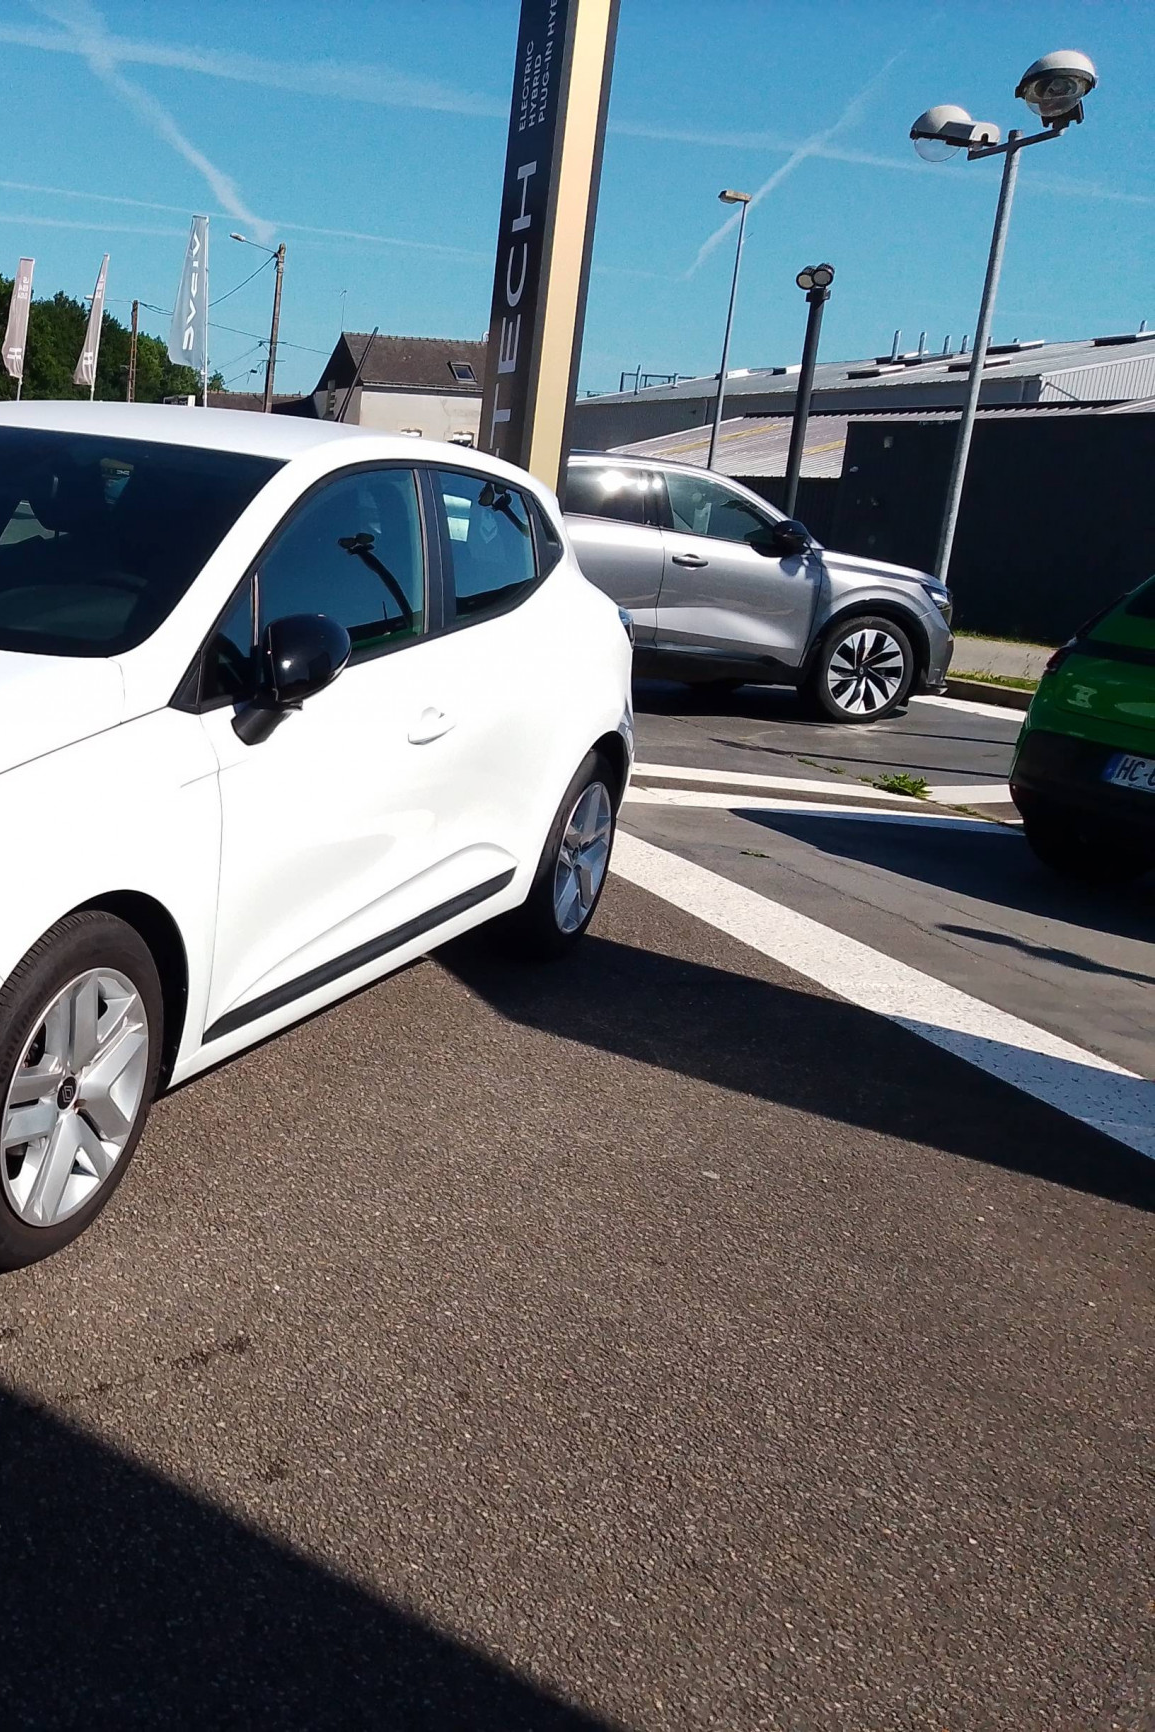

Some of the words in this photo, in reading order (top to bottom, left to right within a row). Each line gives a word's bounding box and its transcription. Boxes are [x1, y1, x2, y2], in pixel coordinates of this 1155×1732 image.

[519, 40, 534, 131] ELECTRIC
[528, 54, 542, 127] HYBRID
[538, 40, 553, 123] PLUG-IN
[489, 160, 538, 456] TECH
